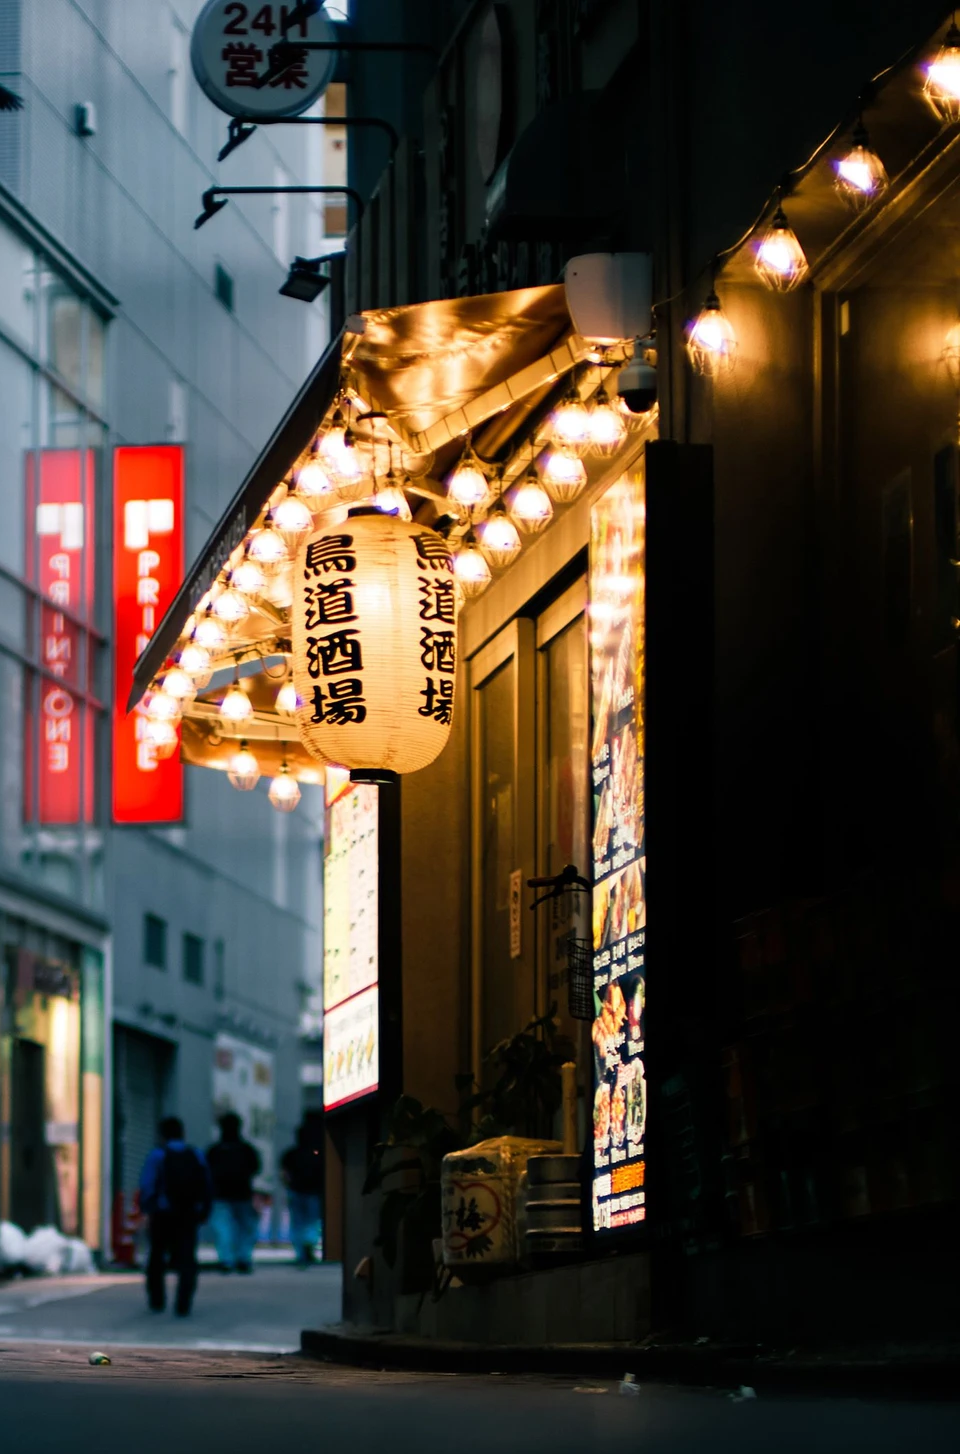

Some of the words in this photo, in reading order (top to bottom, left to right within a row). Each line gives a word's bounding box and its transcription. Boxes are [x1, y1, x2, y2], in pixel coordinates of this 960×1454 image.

[222, 2, 307, 37] 24H
[304, 534, 366, 726] 鳥道酒場
